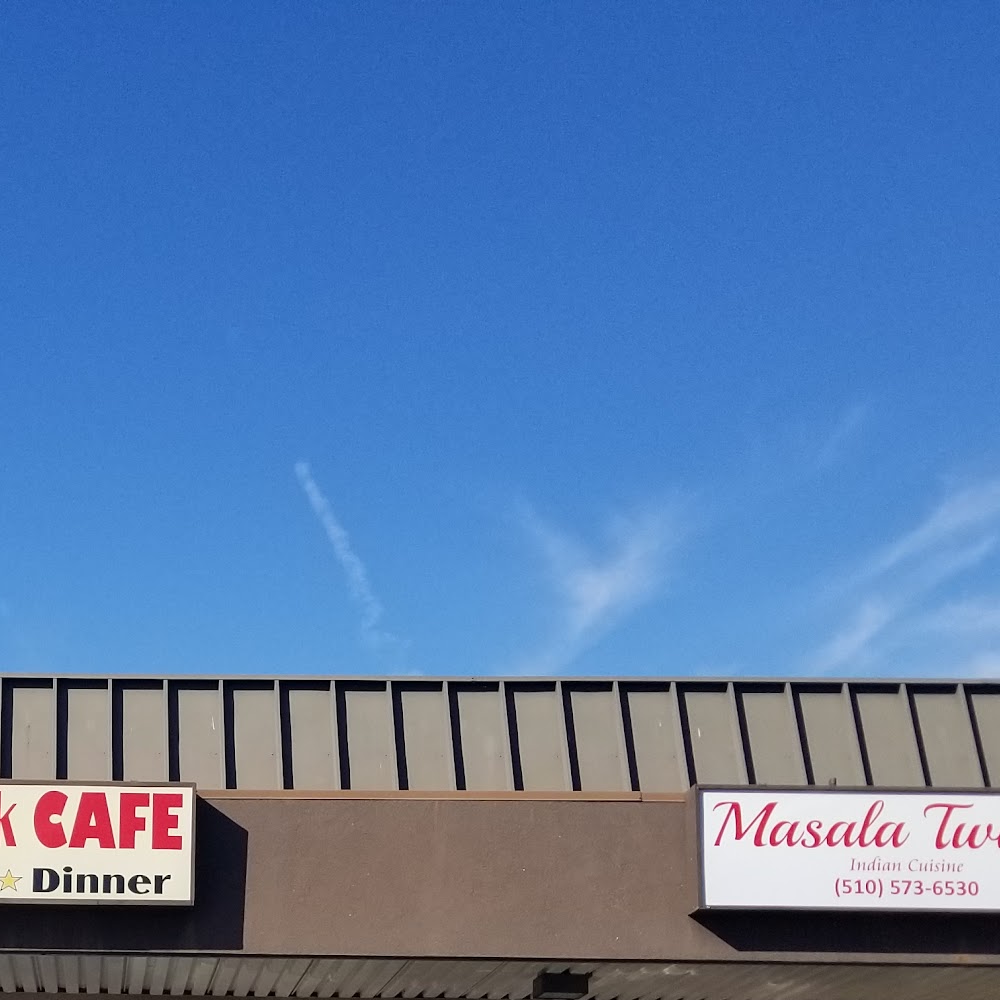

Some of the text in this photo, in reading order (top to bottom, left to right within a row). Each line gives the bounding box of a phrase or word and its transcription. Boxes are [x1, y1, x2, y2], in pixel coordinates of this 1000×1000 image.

[33, 791, 184, 850] CAFE
[712, 799, 1000, 850] Masala Tw
[850, 856, 964, 873] Indian Cuisine
[31, 866, 171, 894] Dinner
[834, 877, 979, 898] (510) 573-6530
